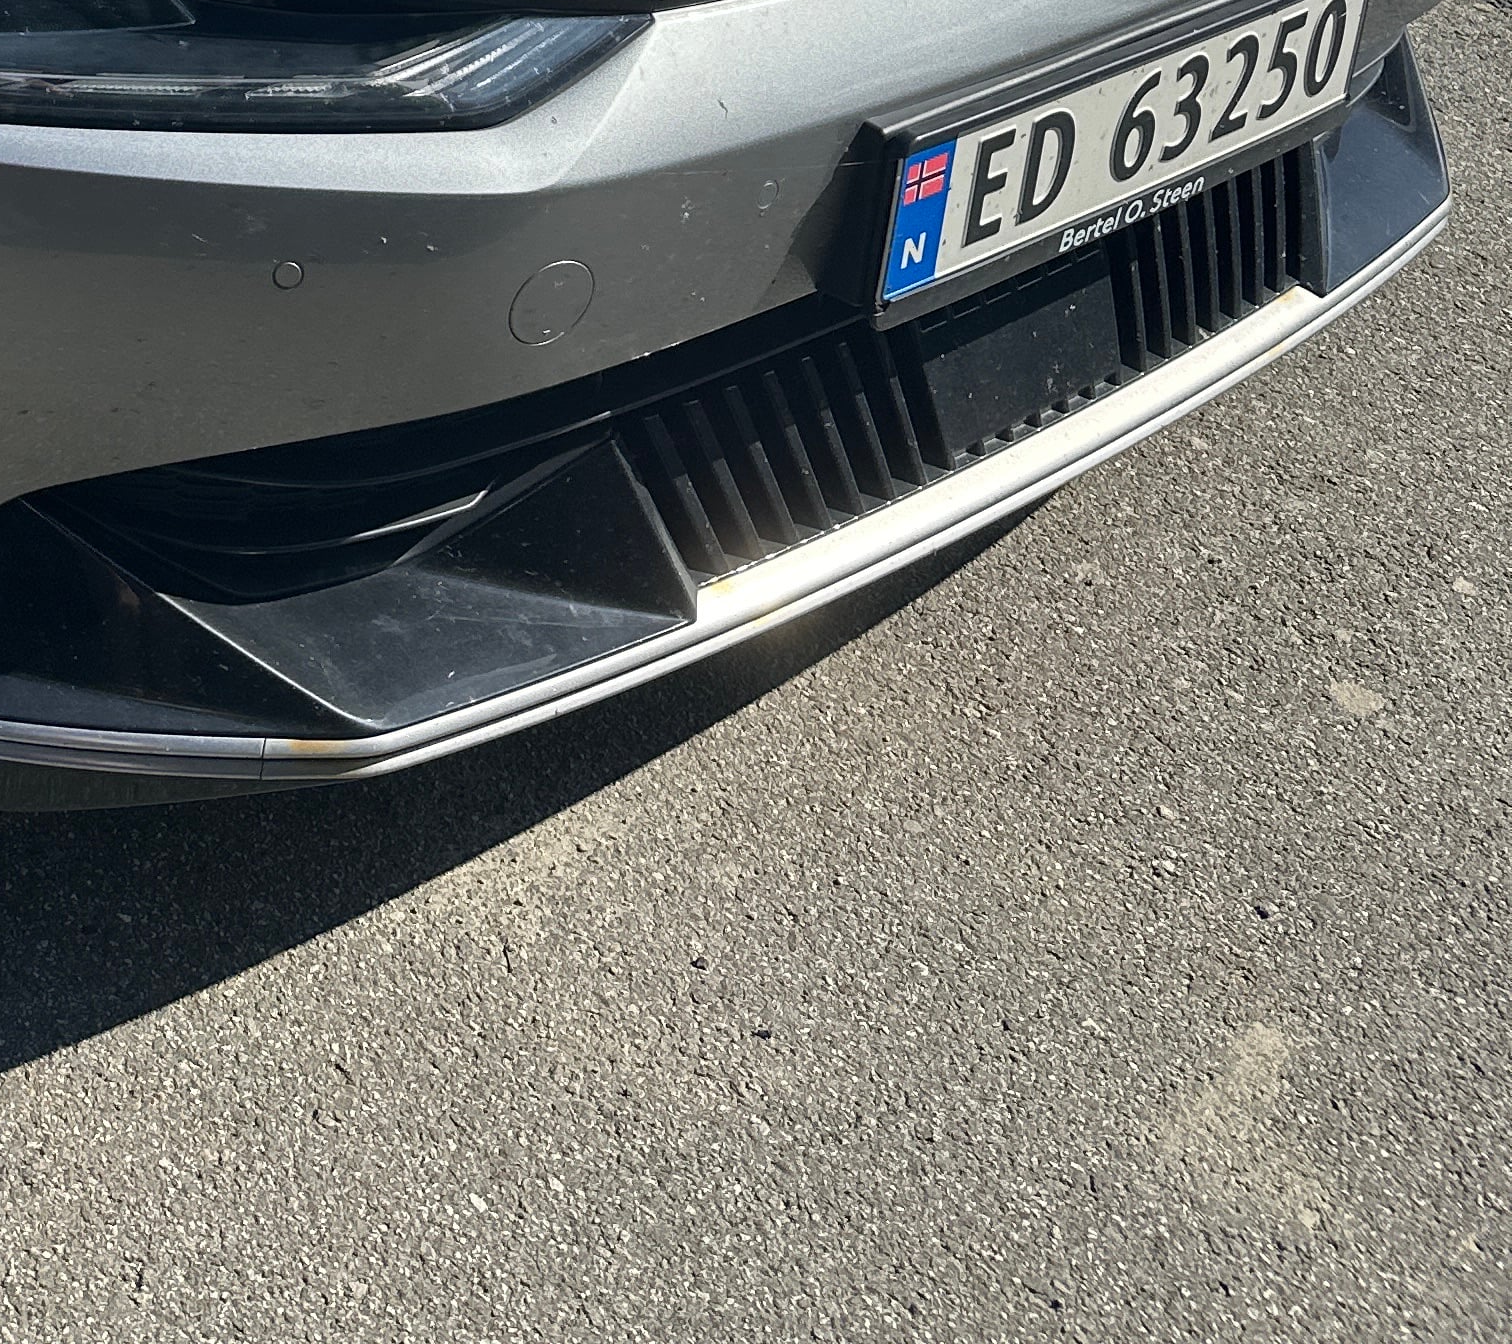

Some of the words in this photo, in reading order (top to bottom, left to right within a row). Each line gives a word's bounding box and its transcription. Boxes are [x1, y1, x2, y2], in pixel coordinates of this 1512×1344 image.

[962, 110, 1076, 248] ED
[1058, 206, 1122, 253] Bertel
[1124, 199, 1146, 224] O.
[1149, 176, 1205, 213] Steen
[900, 231, 927, 270] N
